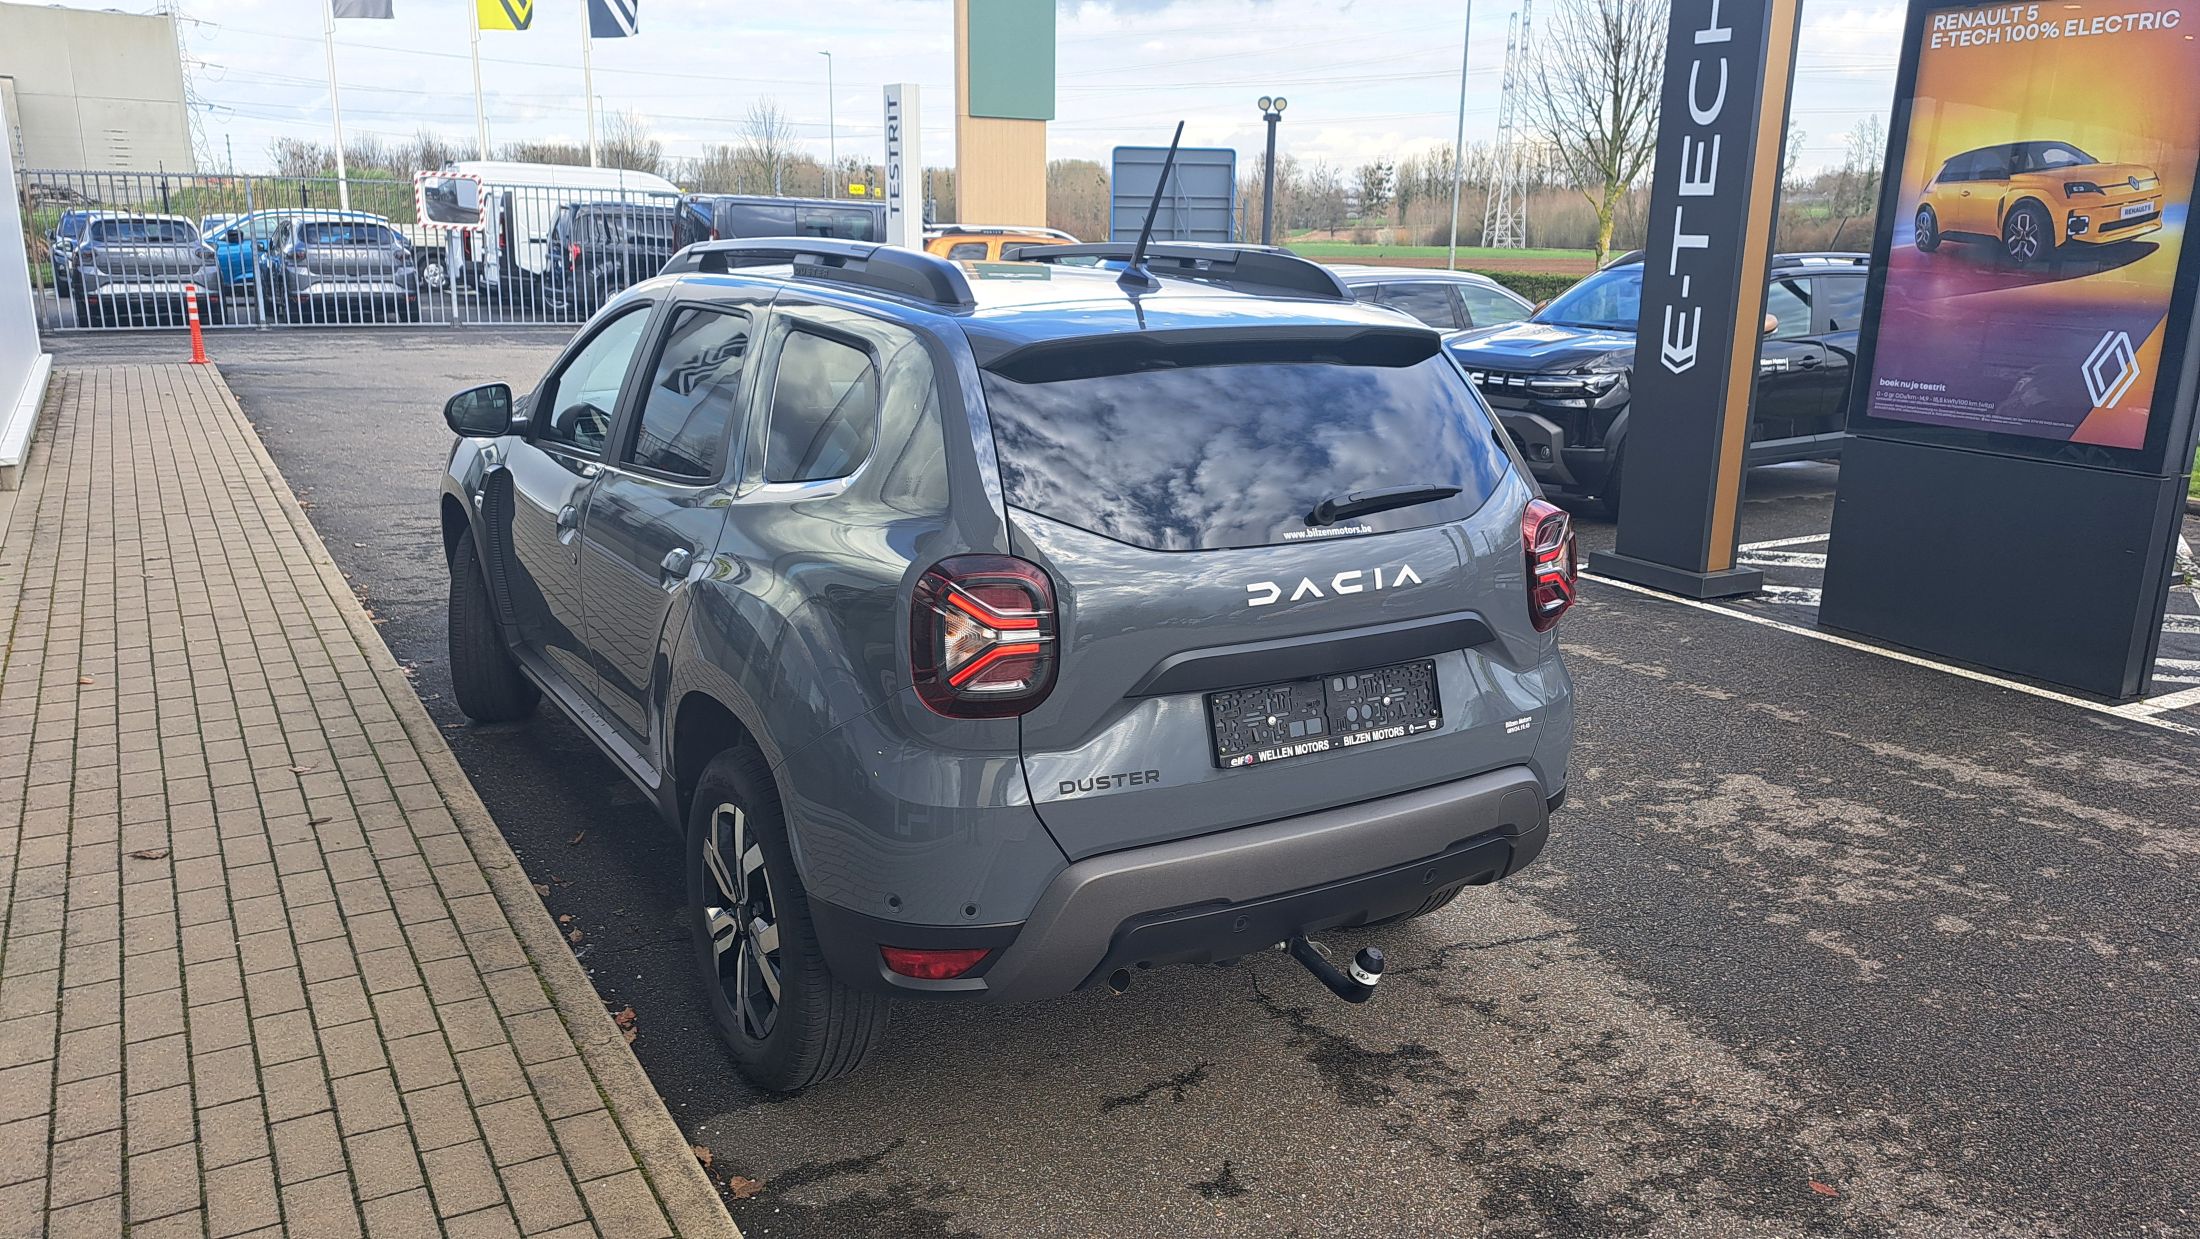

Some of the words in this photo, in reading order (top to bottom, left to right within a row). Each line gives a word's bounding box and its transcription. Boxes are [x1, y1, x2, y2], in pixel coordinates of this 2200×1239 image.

[1930, 28, 2001, 49] E-TECH
[2005, 21, 2060, 42] 100%
[2063, 9, 2181, 38] ELECTRIC
[1933, 6, 2025, 31] RENAULT
[2026, 4, 2039, 22] 5
[887, 94, 900, 220] TESTRIT
[1880, 377, 1900, 387] book
[1910, 380, 1919, 390] je
[1919, 382, 1946, 392] testrit
[1283, 524, 1372, 540] www.bilzenmotors.be
[1247, 563, 1422, 607] DACIA
[1258, 747, 1294, 762] WELLEN
[1294, 740, 1330, 755] MOTORS
[1343, 732, 1372, 746] BILZEN
[1372, 726, 1405, 741] MOTORS
[1230, 757, 1245, 768] elf
[1059, 769, 1160, 795] DUSTER
